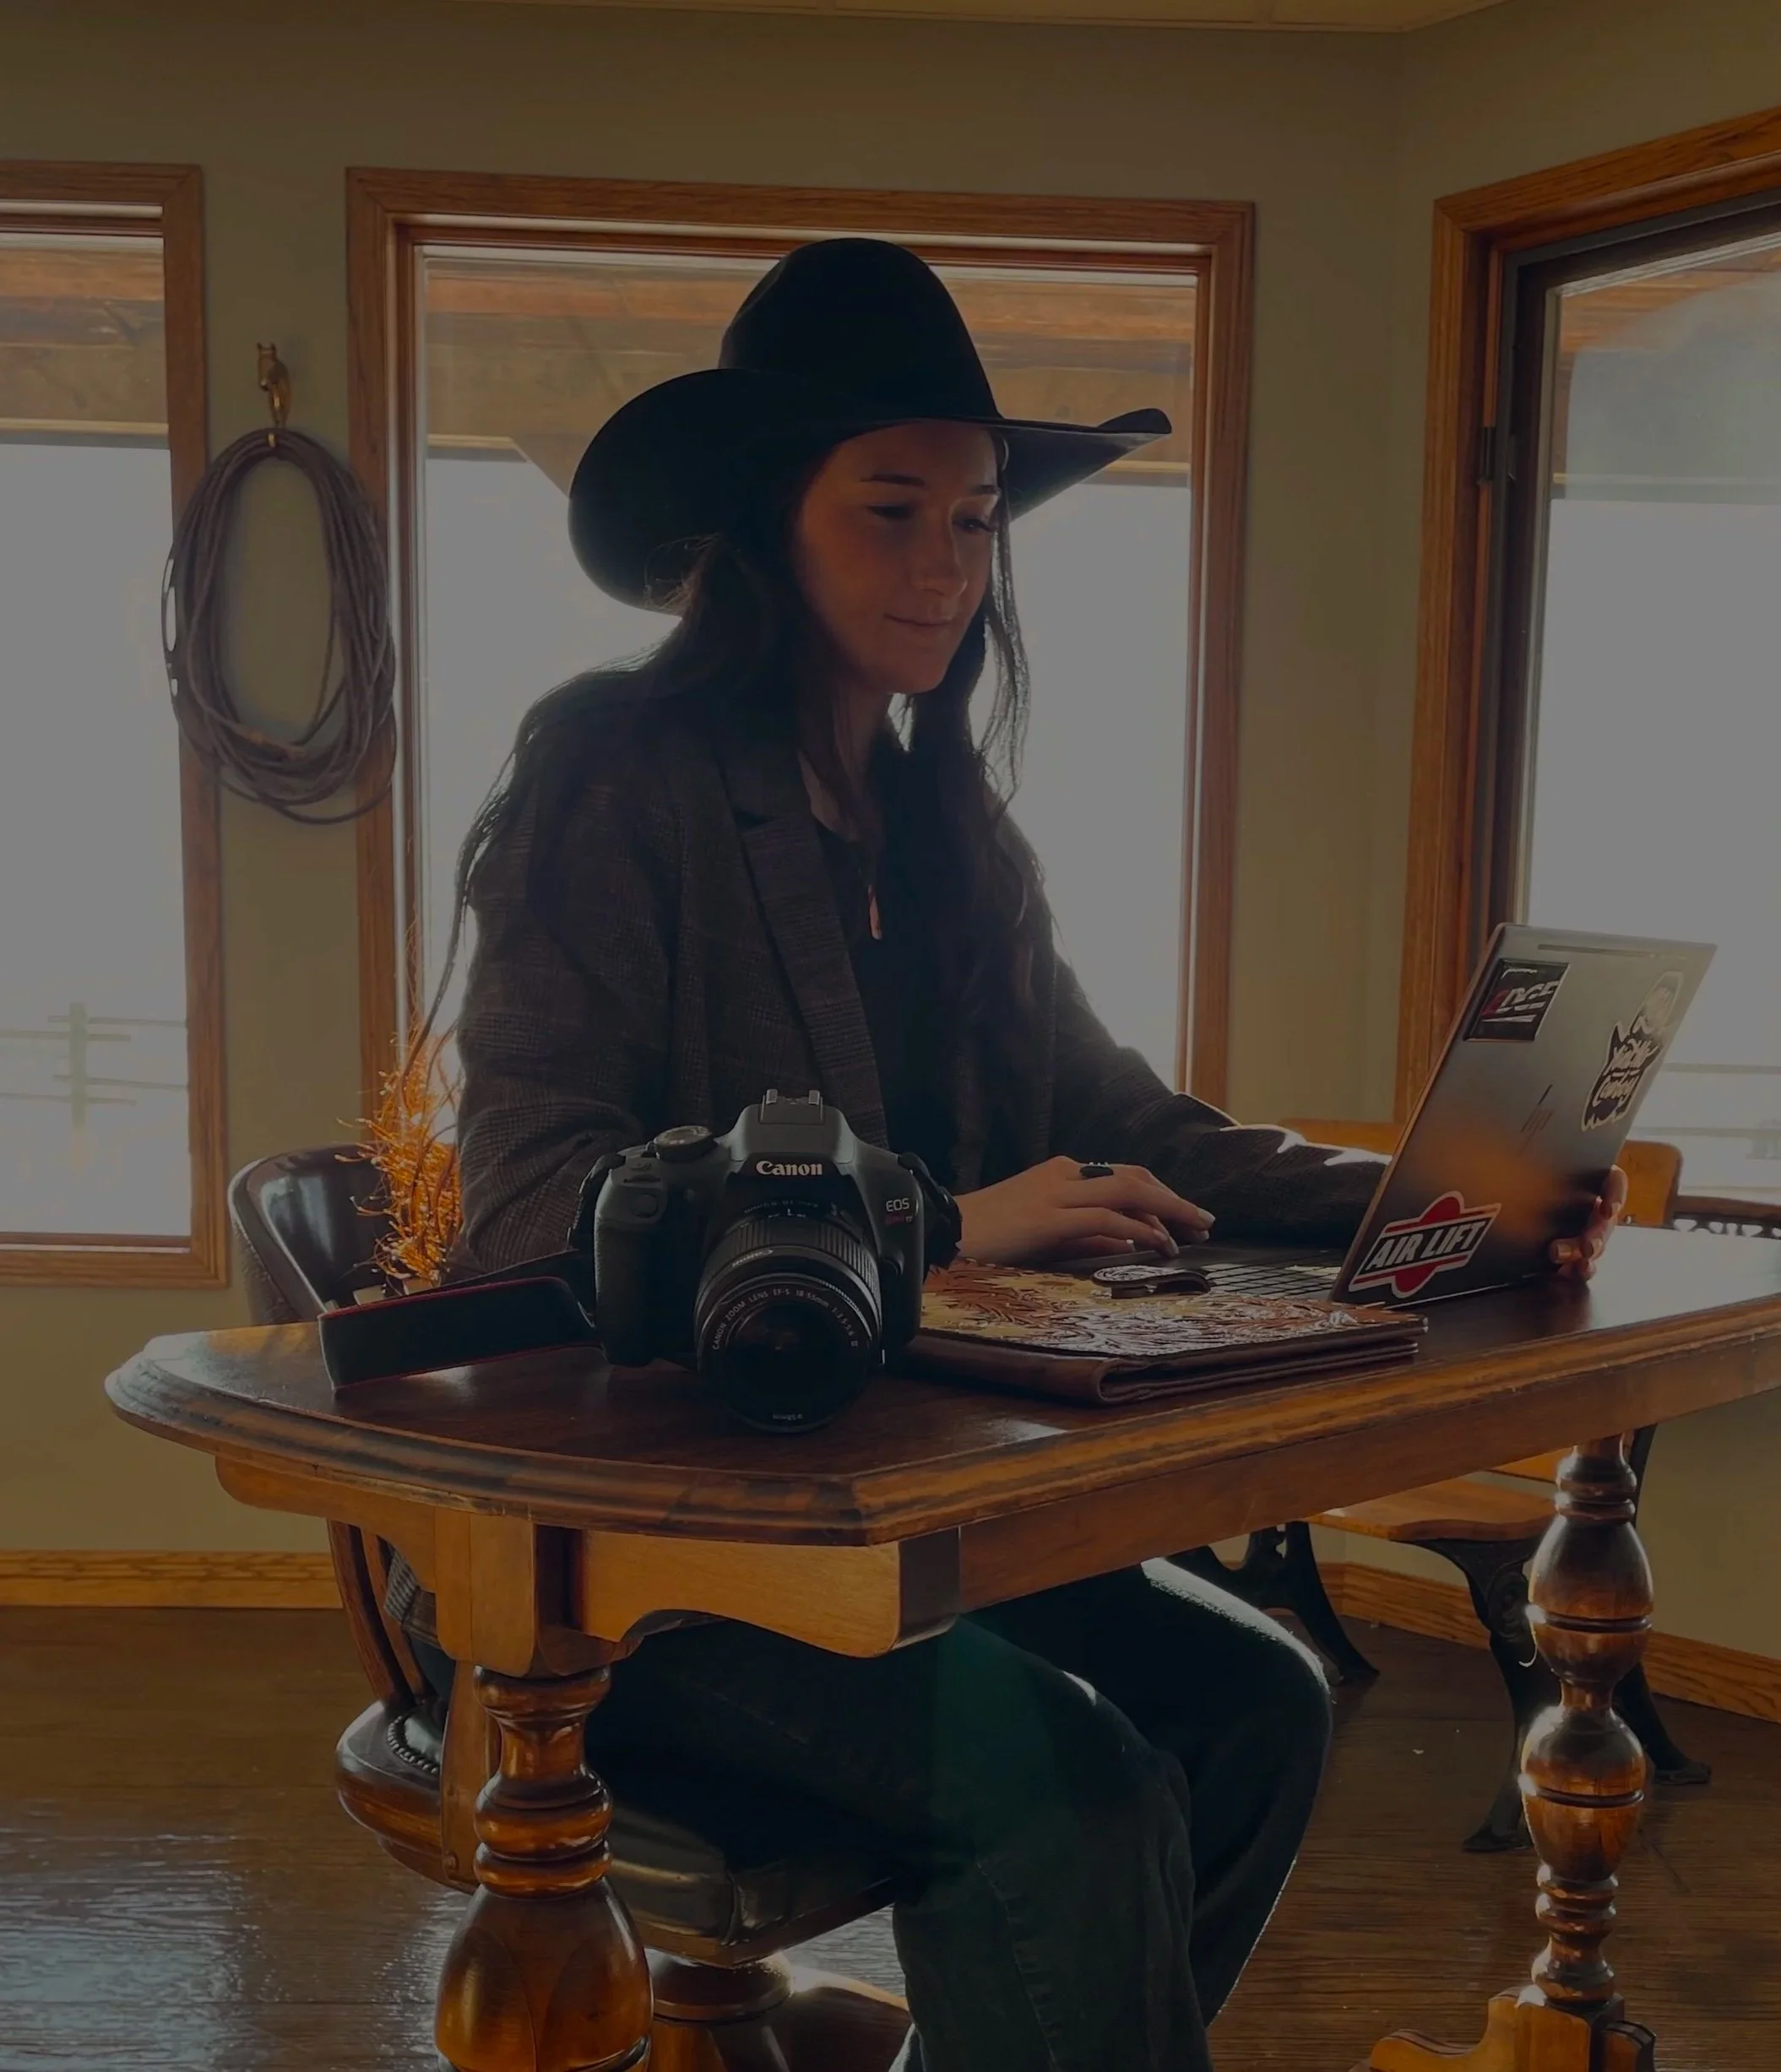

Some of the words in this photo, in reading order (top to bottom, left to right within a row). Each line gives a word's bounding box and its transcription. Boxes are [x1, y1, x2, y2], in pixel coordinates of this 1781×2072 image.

[756, 1160, 823, 1176] Canon
[886, 1197, 910, 1212] EOS
[1365, 1234, 1424, 1271] AIR
[1420, 1220, 1486, 1259] LIFT
[712, 1323, 727, 1351] CANON
[725, 1300, 746, 1321] ZOOM
[748, 1291, 769, 1303] LENS
